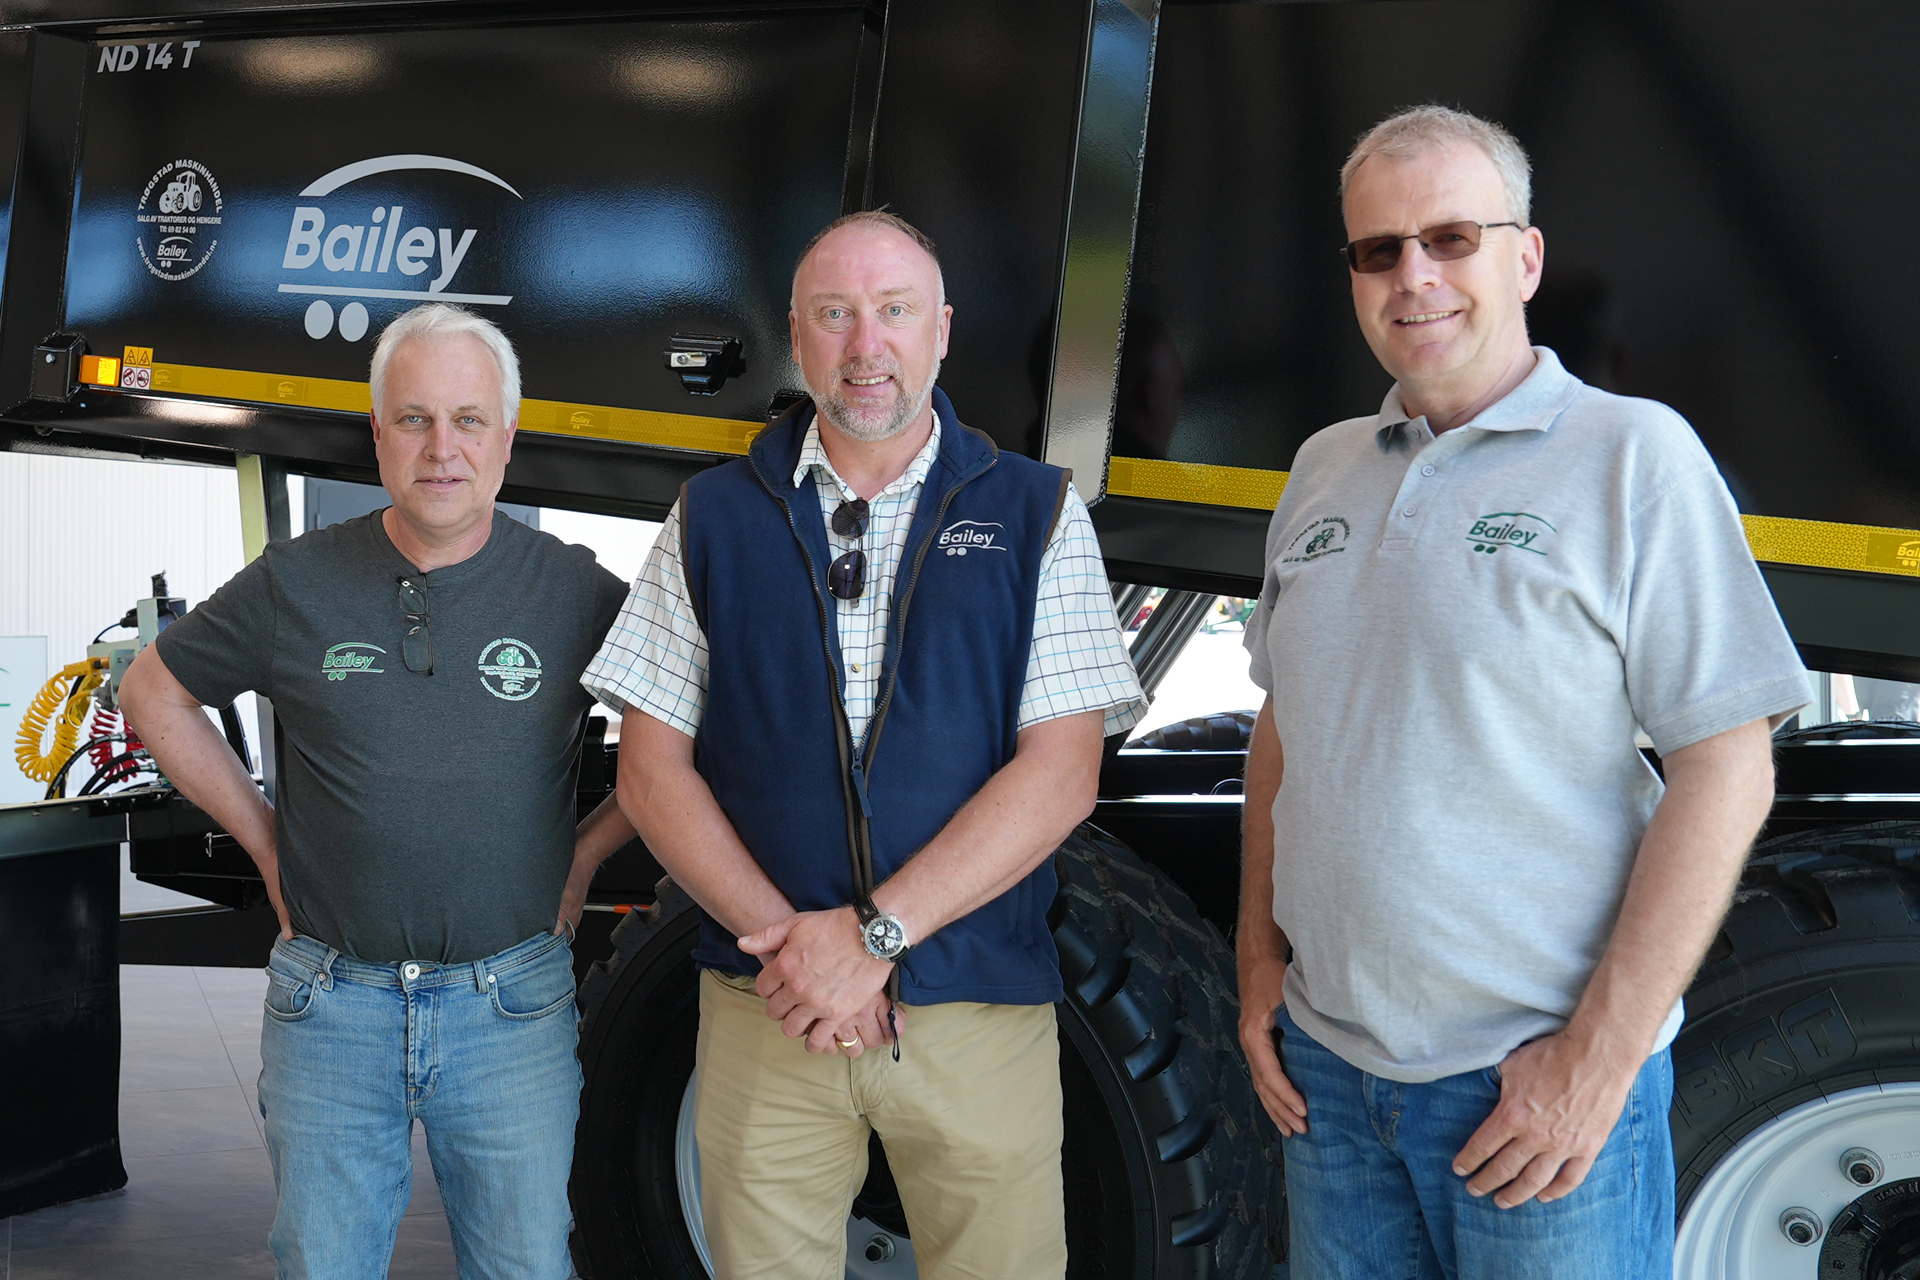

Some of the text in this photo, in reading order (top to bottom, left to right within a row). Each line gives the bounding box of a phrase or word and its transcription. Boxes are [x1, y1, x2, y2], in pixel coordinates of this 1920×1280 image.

[97, 41, 200, 73] ND 14 T
[138, 159, 223, 213] TRØGSTAD MASKINHANDEL
[158, 215, 187, 224] TRAKTORER
[187, 216, 196, 224] OG
[157, 244, 188, 259] Bailey
[282, 206, 478, 293] Bailey
[939, 529, 995, 547] Bailey
[1469, 520, 1539, 548] Bailey
[322, 651, 375, 670] Bailey
[1676, 1007, 1837, 1116] BKT
